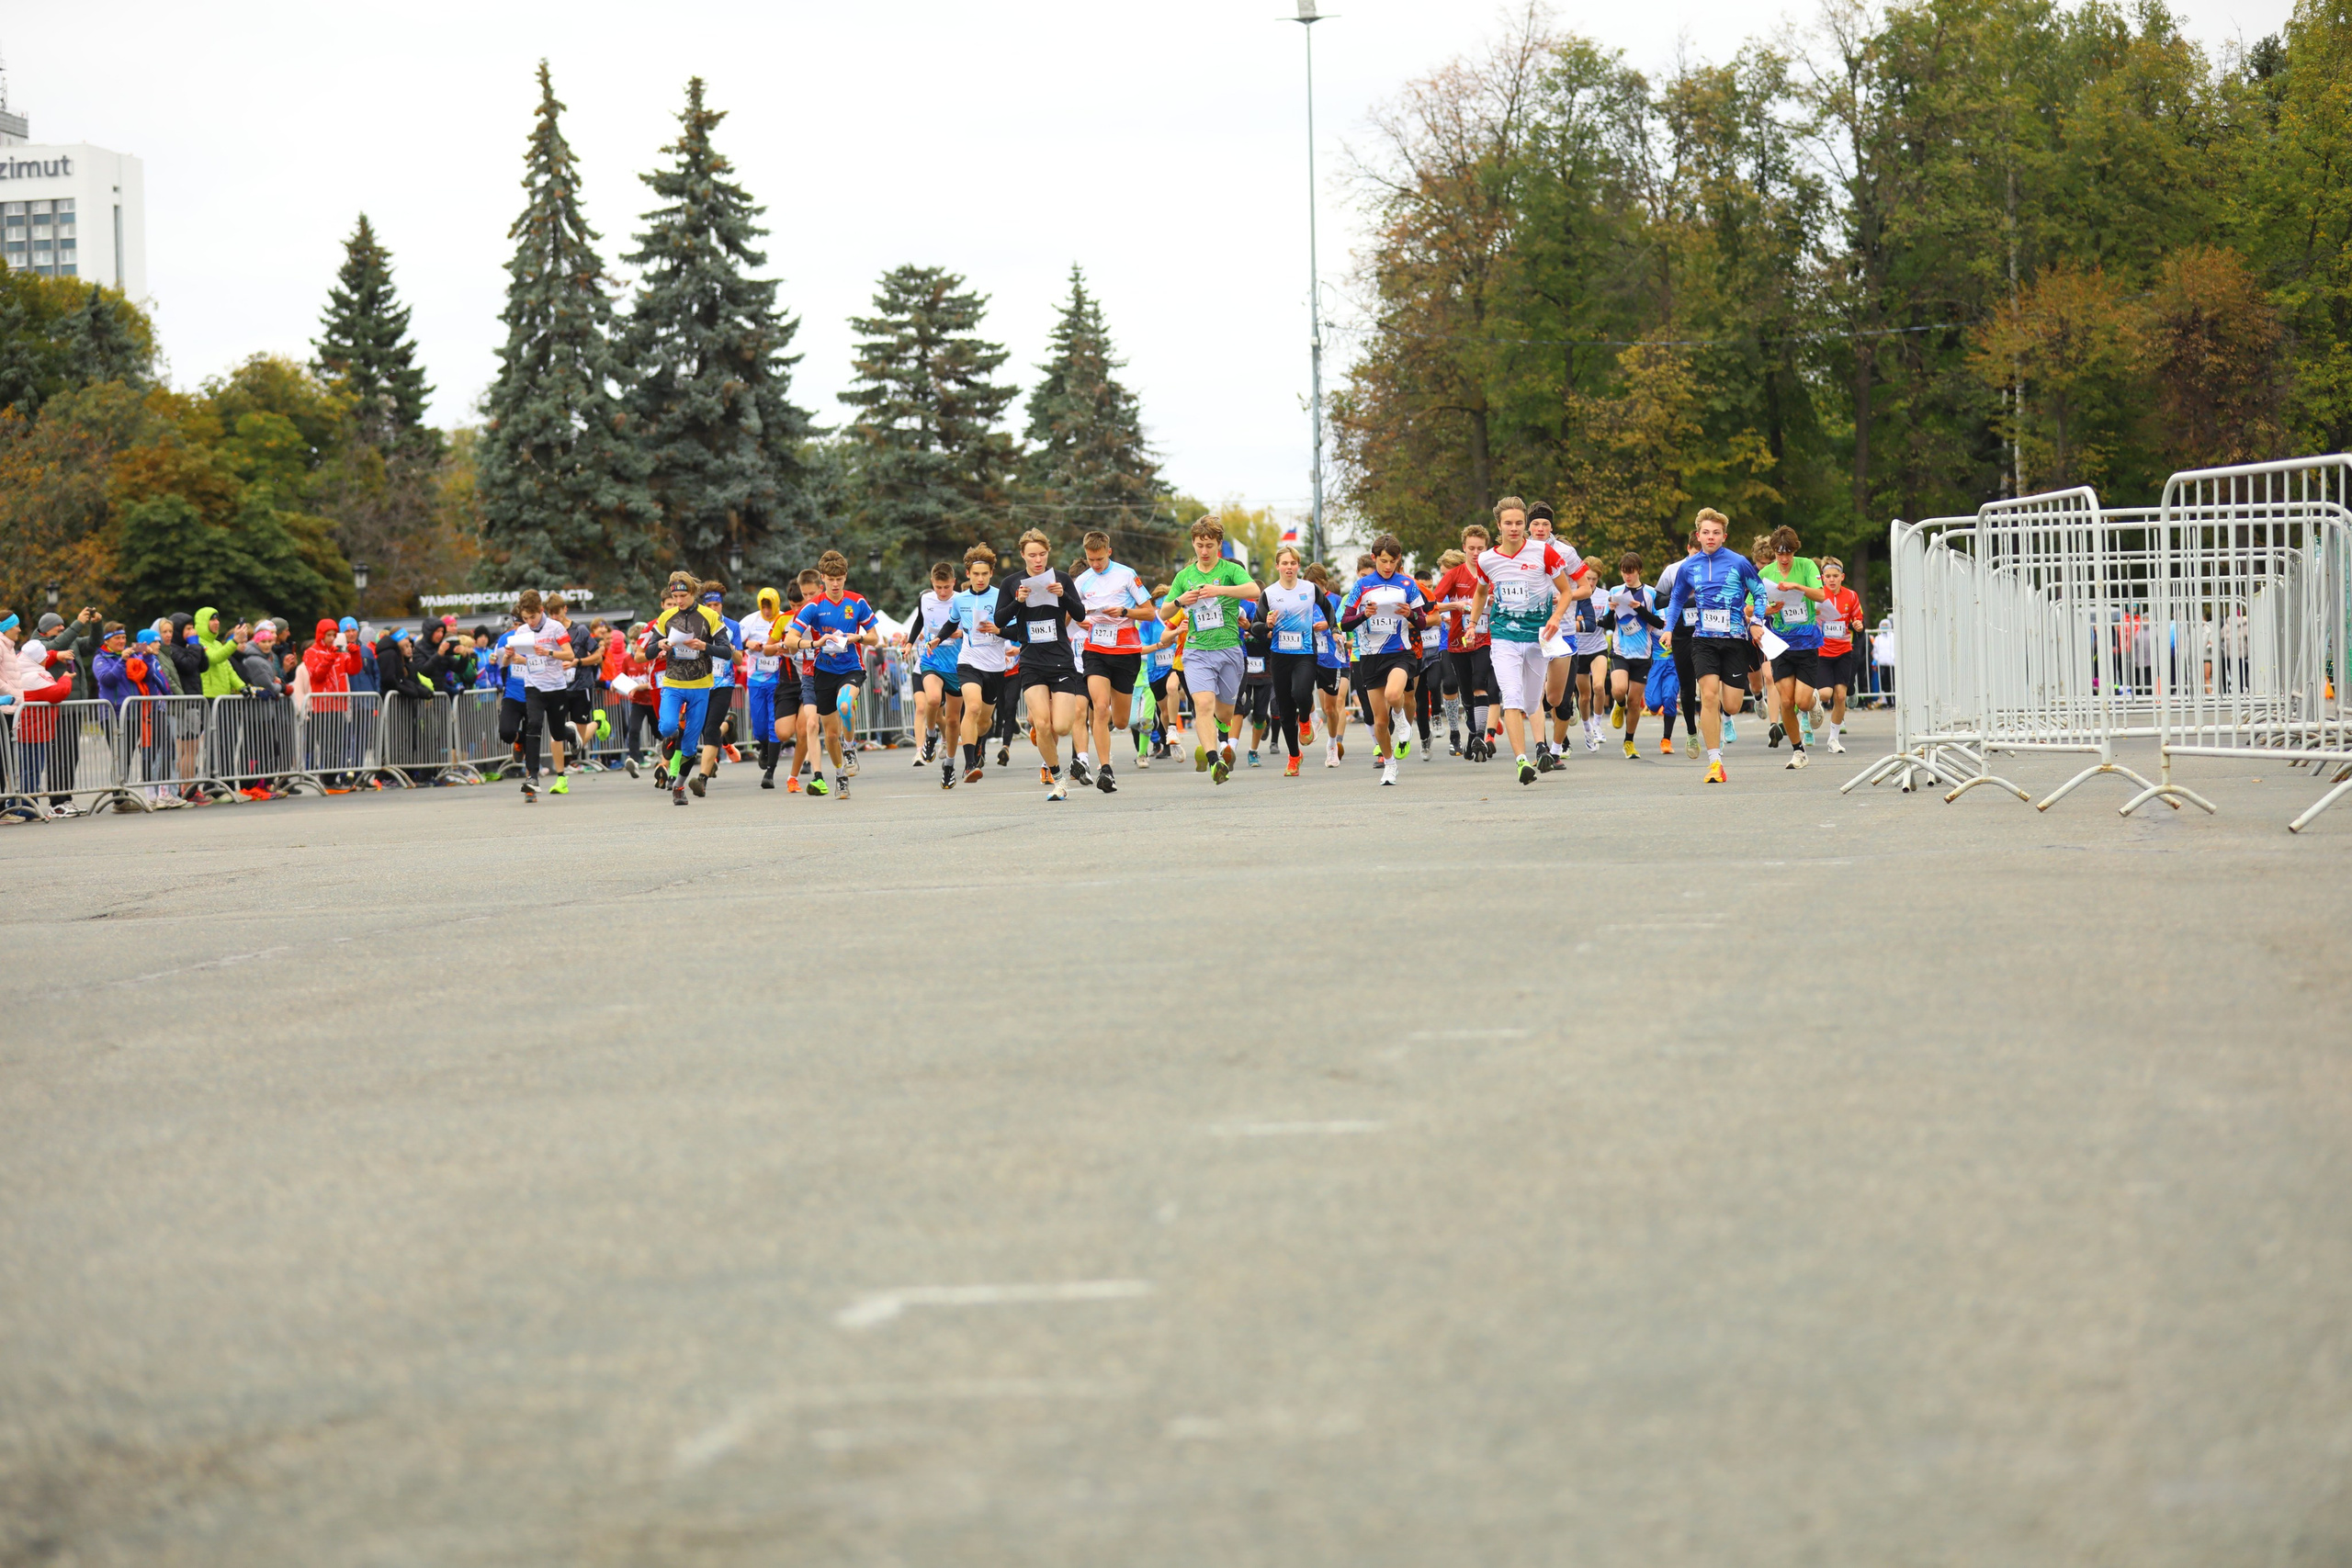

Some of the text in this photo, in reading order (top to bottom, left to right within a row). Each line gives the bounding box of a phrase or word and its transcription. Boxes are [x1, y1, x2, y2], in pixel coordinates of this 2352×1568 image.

[0, 155, 72, 179] zimut
[1501, 587, 1523, 595] 314.1
[420, 589, 594, 607] УЛЬЯНОВСКАЯ БАСТЬ
[1784, 608, 1804, 616] 320.1
[1196, 612, 1218, 622] 312.1
[1704, 614, 1724, 623] 339.1
[1030, 626, 1052, 635] 308.1
[760, 659, 775, 667] 304.1
